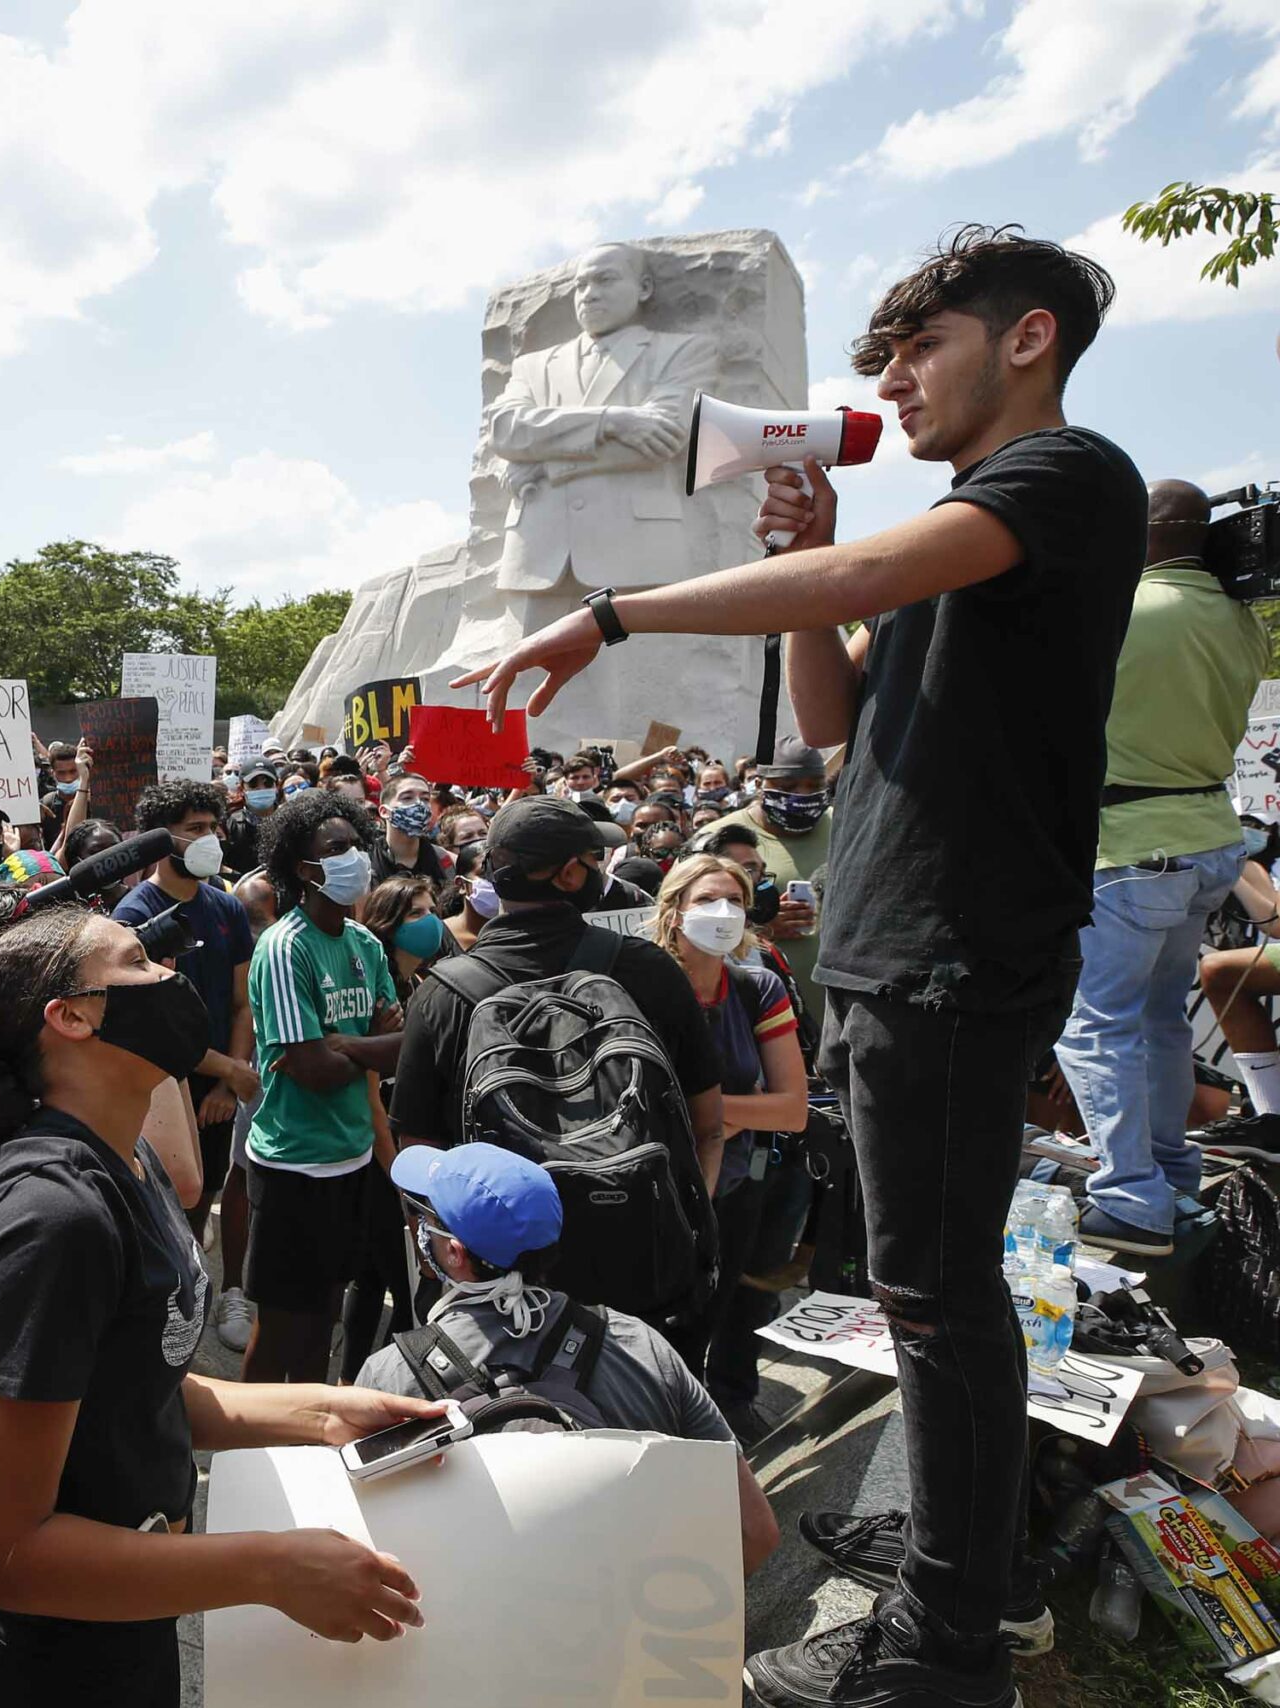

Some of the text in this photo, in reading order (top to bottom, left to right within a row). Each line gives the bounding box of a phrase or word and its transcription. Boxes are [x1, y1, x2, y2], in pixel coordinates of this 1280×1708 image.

[763, 424, 807, 438] PYLE
[161, 658, 208, 681] JUSTICE
[344, 684, 417, 748] #BLM
[91, 845, 141, 879] RØDE
[775, 1304, 857, 1342] YOU?
[1028, 1354, 1124, 1429] DOES
[1184, 1502, 1214, 1539] VALUE
[1212, 1541, 1238, 1572] PACK
